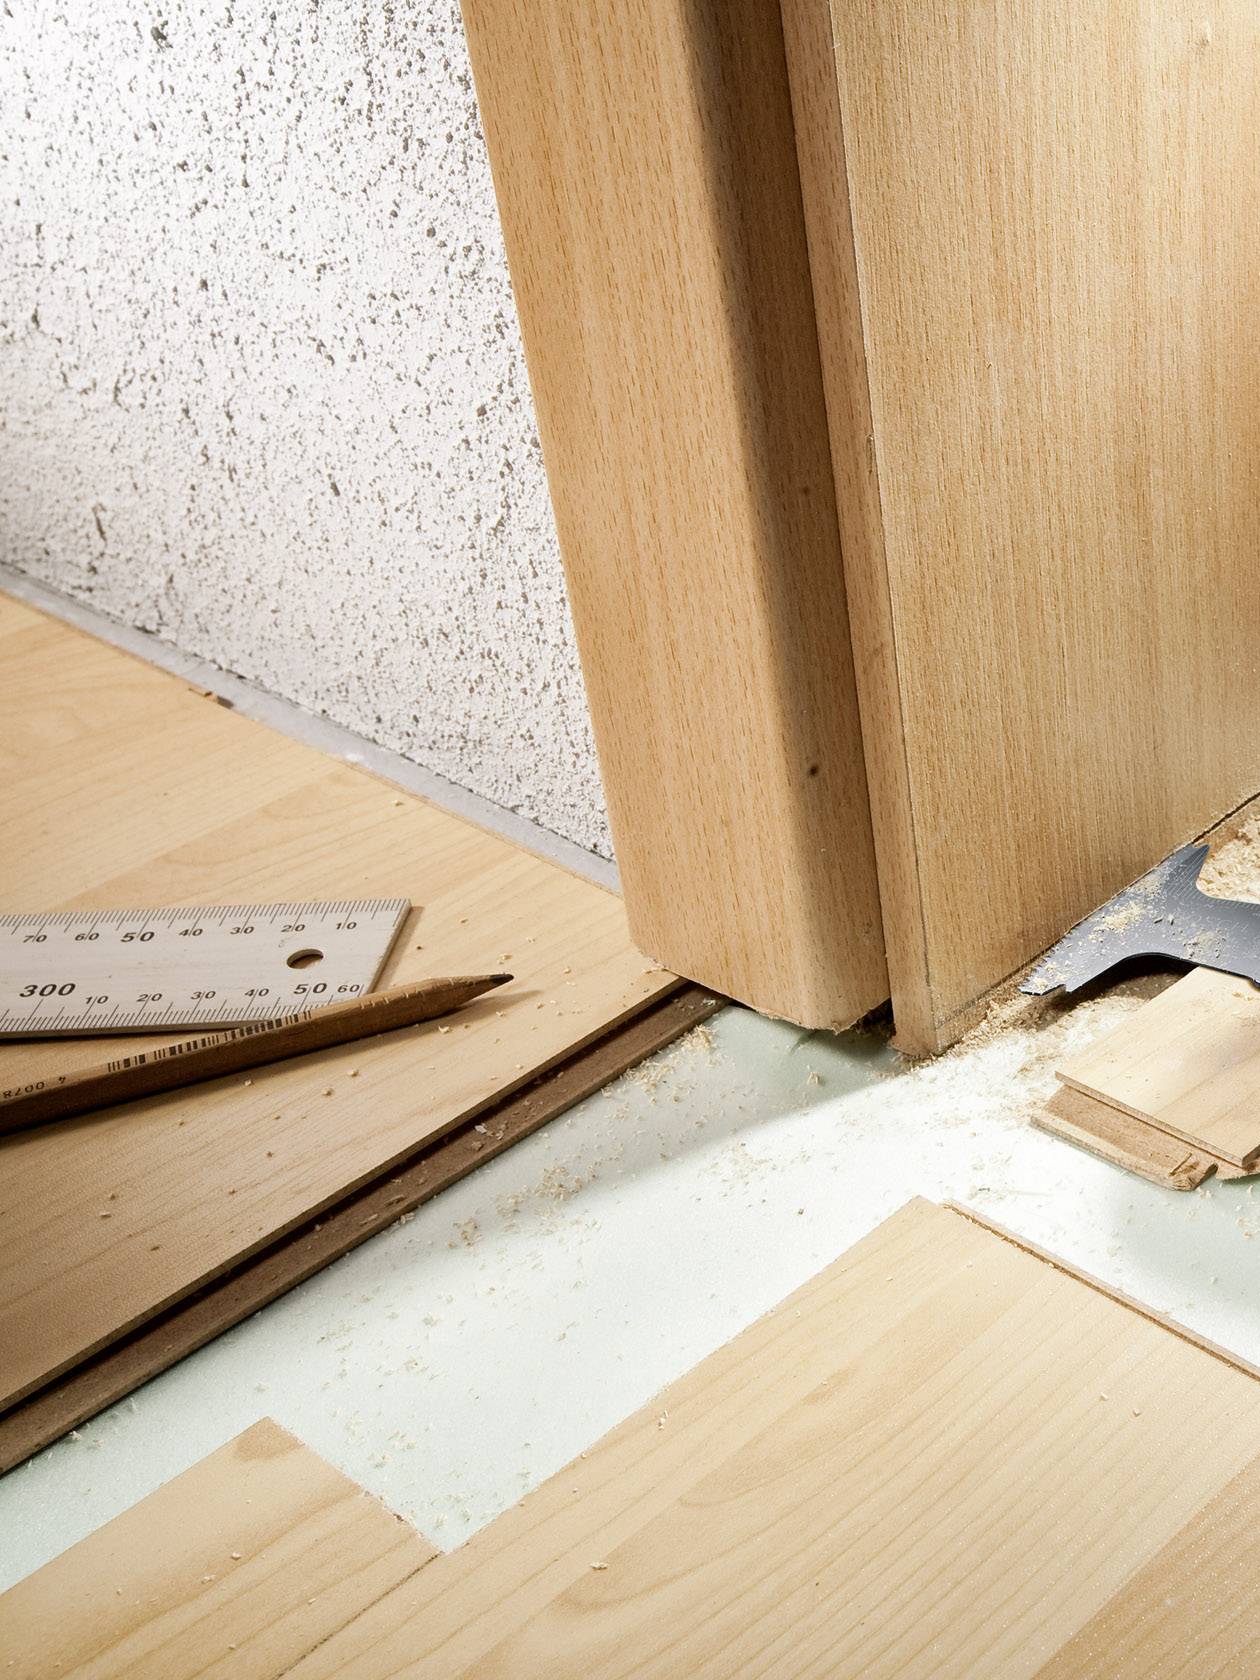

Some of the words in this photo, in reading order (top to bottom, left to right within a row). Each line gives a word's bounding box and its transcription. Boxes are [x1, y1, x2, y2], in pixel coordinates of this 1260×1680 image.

[23, 934, 48, 943] 70
[74, 932, 100, 942] 60
[120, 931, 155, 943] 50
[178, 928, 204, 937] 40
[230, 926, 255, 935] 30
[280, 923, 305, 933] 20
[336, 921, 358, 931] 10
[19, 983, 76, 998] 300
[85, 995, 109, 1005] 10
[136, 992, 163, 1003] 20
[190, 990, 216, 1000] 30
[244, 988, 270, 997] 40
[293, 982, 328, 995] 50
[337, 984, 361, 993] 60
